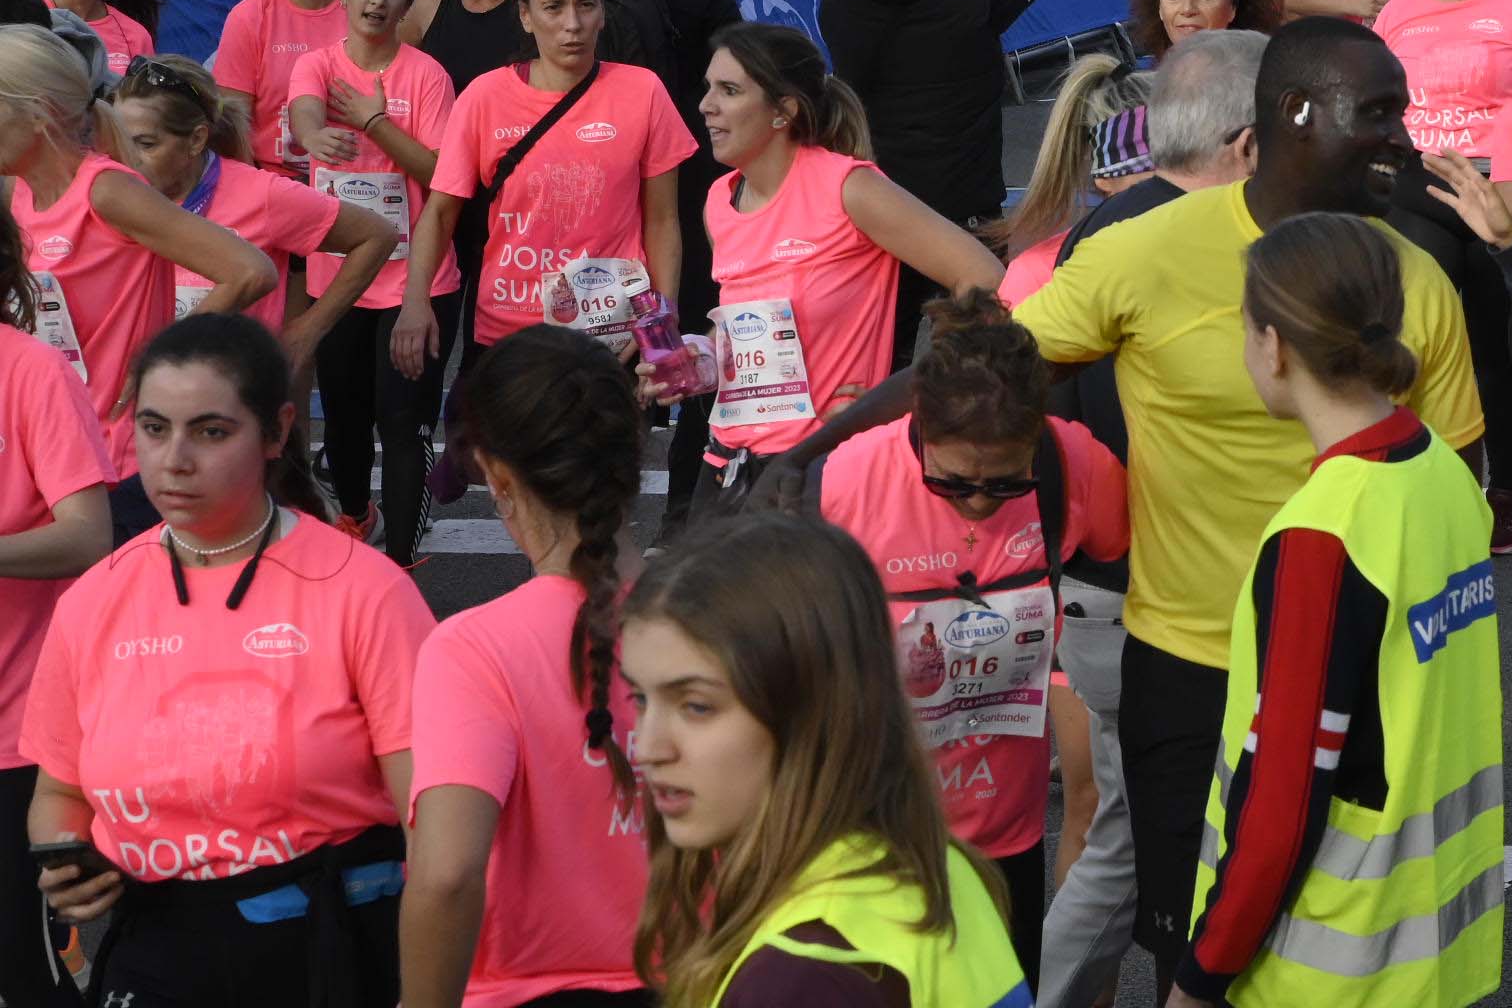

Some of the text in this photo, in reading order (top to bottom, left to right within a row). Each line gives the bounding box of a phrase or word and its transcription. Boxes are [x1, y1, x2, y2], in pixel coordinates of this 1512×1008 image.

[1409, 88, 1427, 107] U
[495, 125, 531, 141] OYSH
[1408, 129, 1474, 148] SUMA
[498, 244, 590, 272] DORSA
[493, 278, 544, 304] SUM
[581, 296, 618, 313] 016
[735, 350, 766, 369] 016
[757, 387, 782, 396] MUJER
[887, 551, 957, 574] OYSHO
[1015, 609, 1044, 621] SUMA
[115, 635, 183, 661] OYSHO
[949, 656, 999, 679] 016
[919, 703, 951, 719] ARRERA
[978, 712, 1032, 724] Santander
[94, 786, 151, 825] TU
[119, 828, 306, 878] DORSAL
